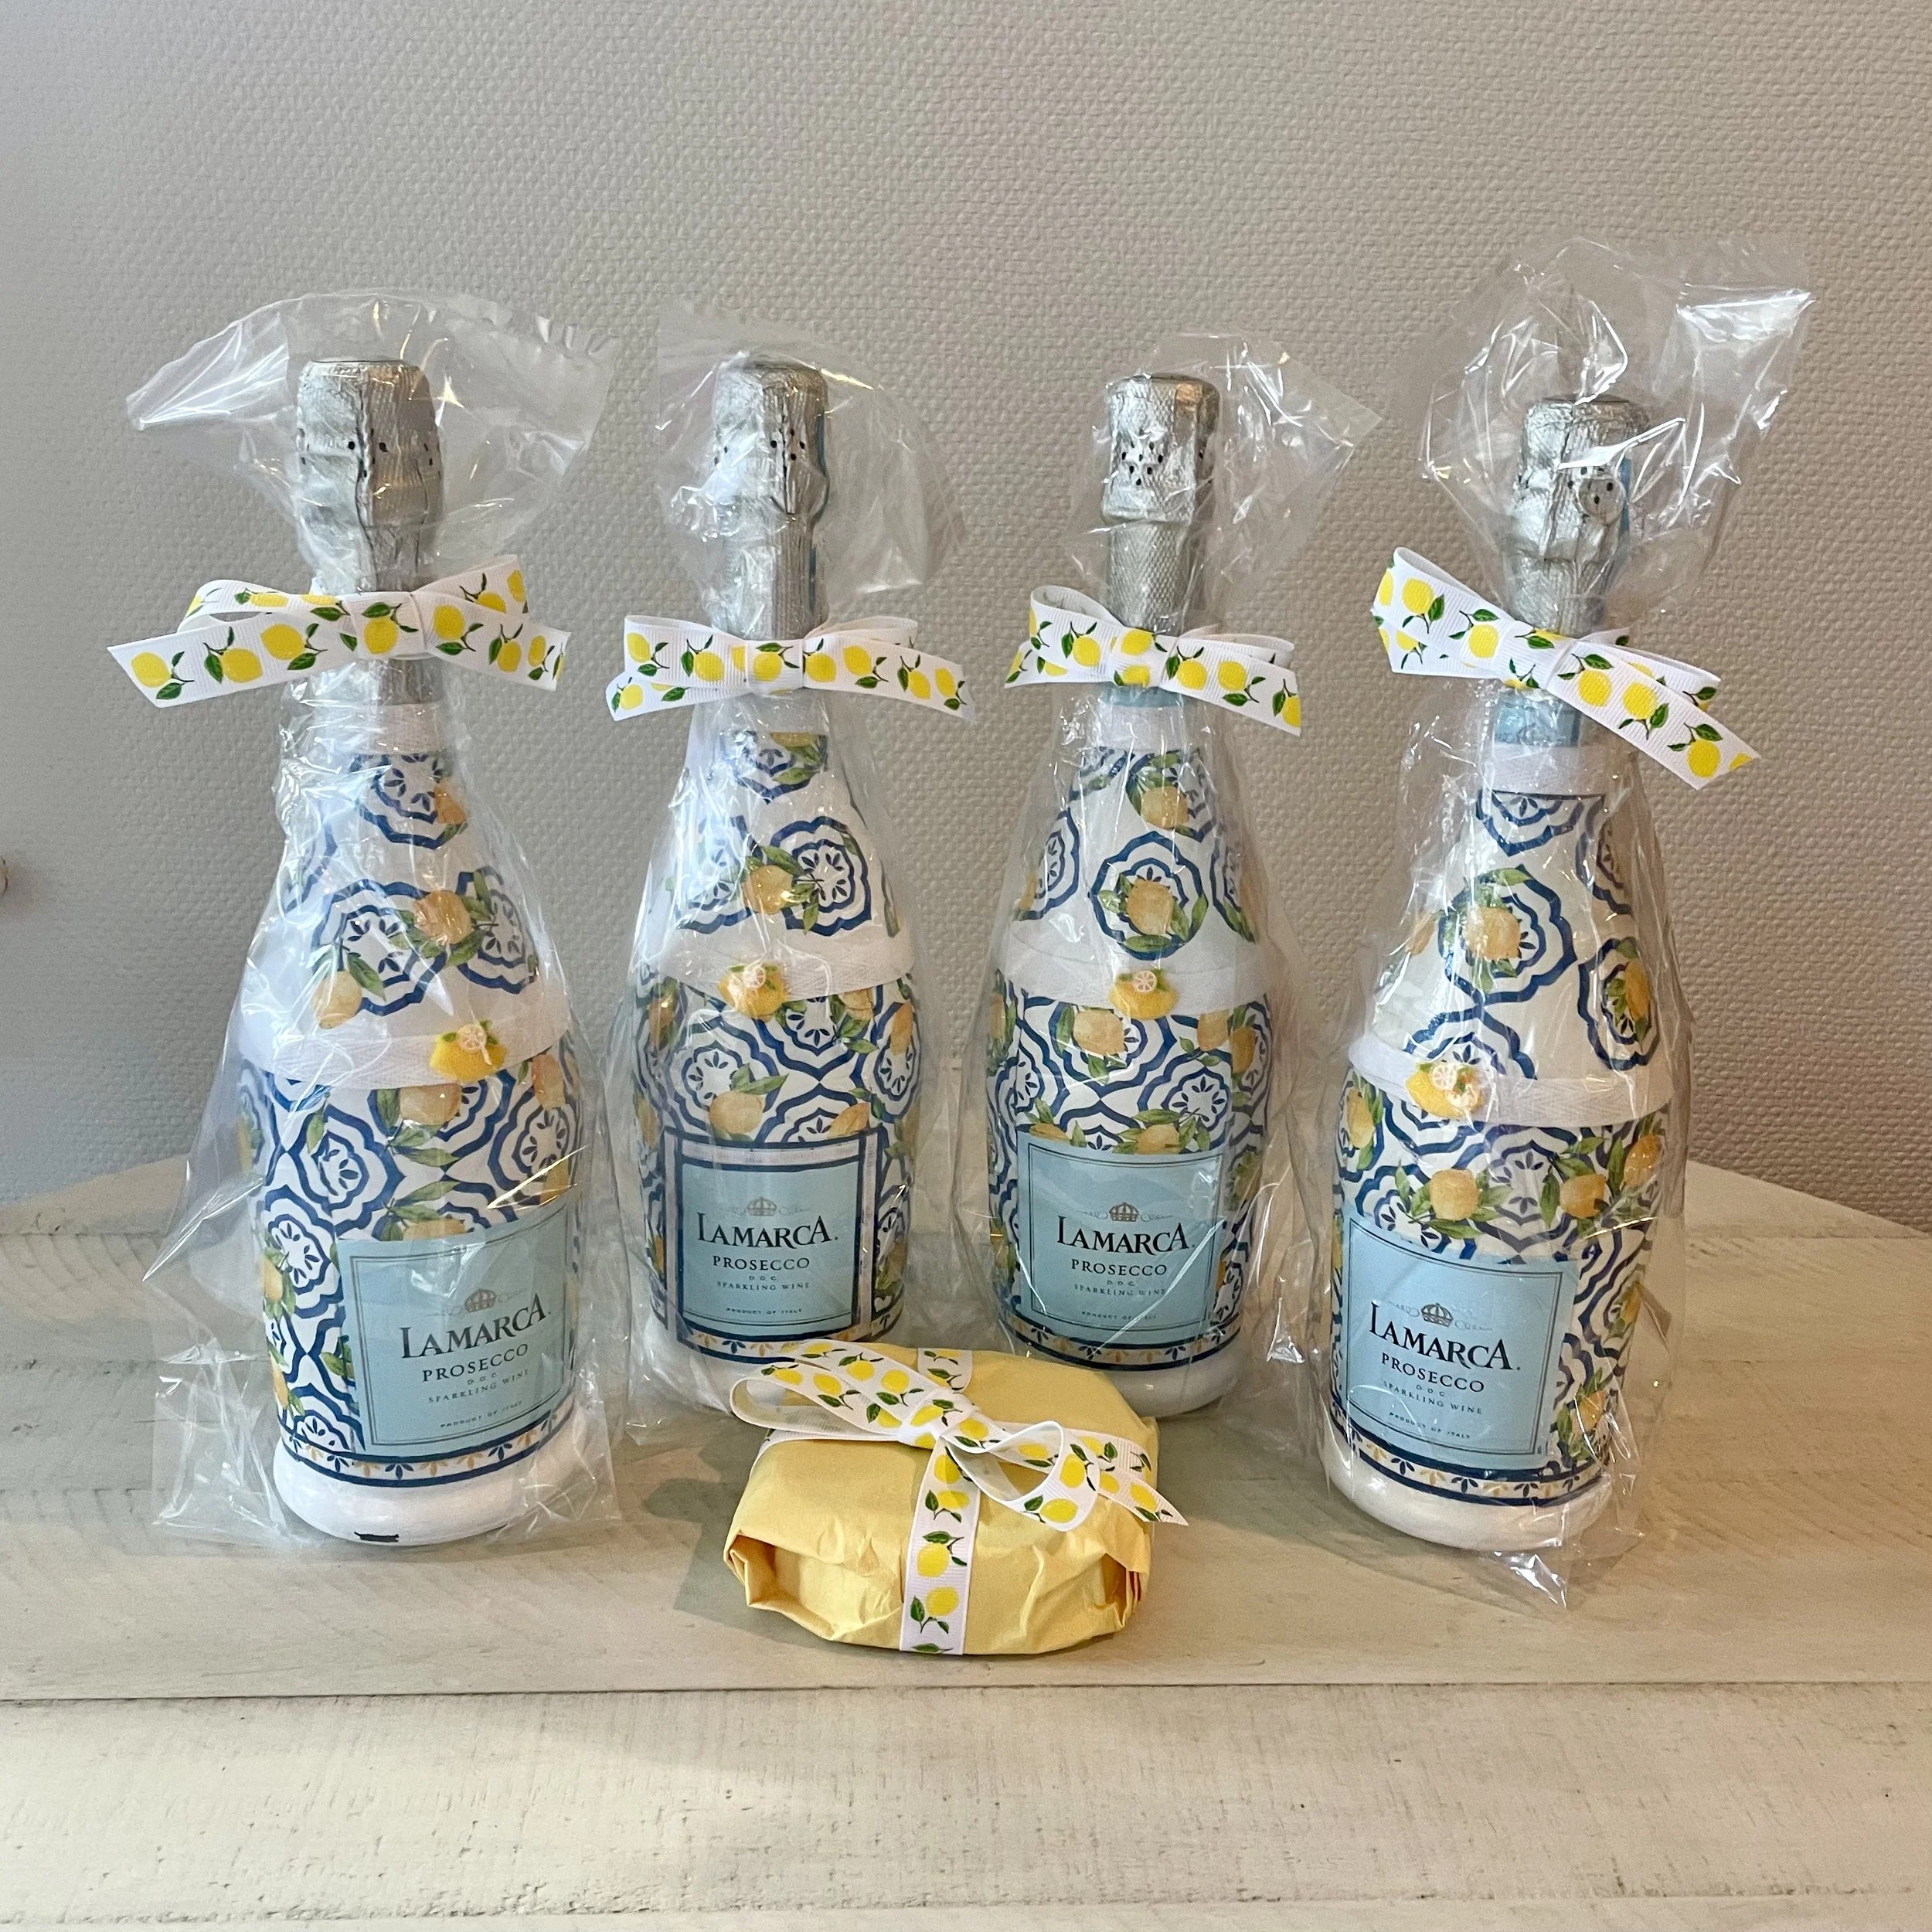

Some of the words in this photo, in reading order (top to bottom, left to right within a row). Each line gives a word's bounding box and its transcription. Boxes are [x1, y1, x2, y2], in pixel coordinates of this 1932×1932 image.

[697, 1212, 832, 1249] LAMARCA
[1056, 1215, 1189, 1256] LAMARCA
[713, 1255, 810, 1270] PROSECCO
[1071, 1258, 1167, 1277] PROSECCO
[717, 1281, 777, 1291] SPARKLING
[1073, 1284, 1134, 1296] SPARKLING
[399, 1293, 546, 1359] LAMARCA
[1369, 1301, 1513, 1370] LAMARCA
[422, 1344, 528, 1383] PROSECCO
[1381, 1352, 1485, 1393] PROSECCO
[428, 1382, 497, 1403] SPARKLING
[502, 1369, 529, 1384] WINE
[1383, 1380, 1444, 1407] SPARKLING
[1450, 1403, 1482, 1415] WINE
